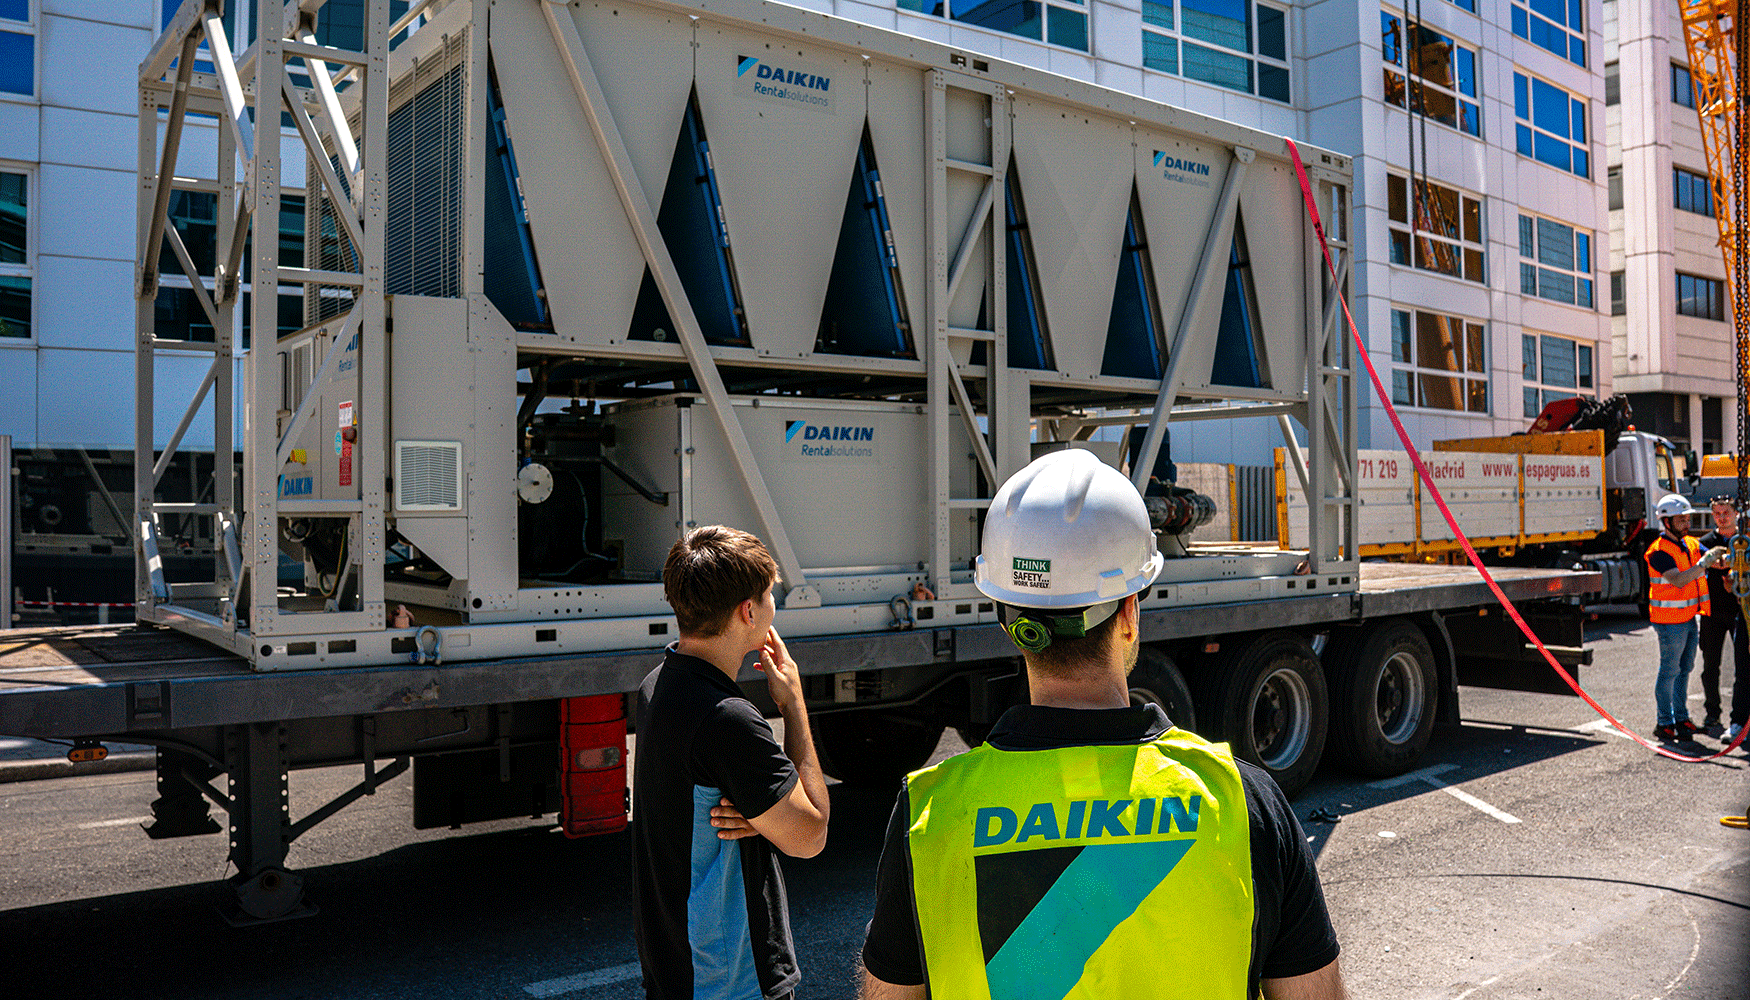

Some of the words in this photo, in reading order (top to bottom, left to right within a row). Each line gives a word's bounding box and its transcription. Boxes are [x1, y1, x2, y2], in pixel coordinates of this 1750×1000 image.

[756, 64, 831, 92] DAIKIN
[753, 81, 829, 107] Rentalsolutions
[1165, 156, 1210, 176] DAIKIN
[803, 425, 875, 441] DAIKIN
[801, 444, 873, 457] Rentalsolutions
[1358, 459, 1373, 479] 71
[1379, 459, 1398, 479] 219
[1423, 460, 1465, 479] Madrid
[1526, 463, 1590, 482] espagruas.es
[284, 477, 313, 496] DAIKIN
[1016, 560, 1046, 570] THINK
[973, 795, 1202, 848] DAIKIN
